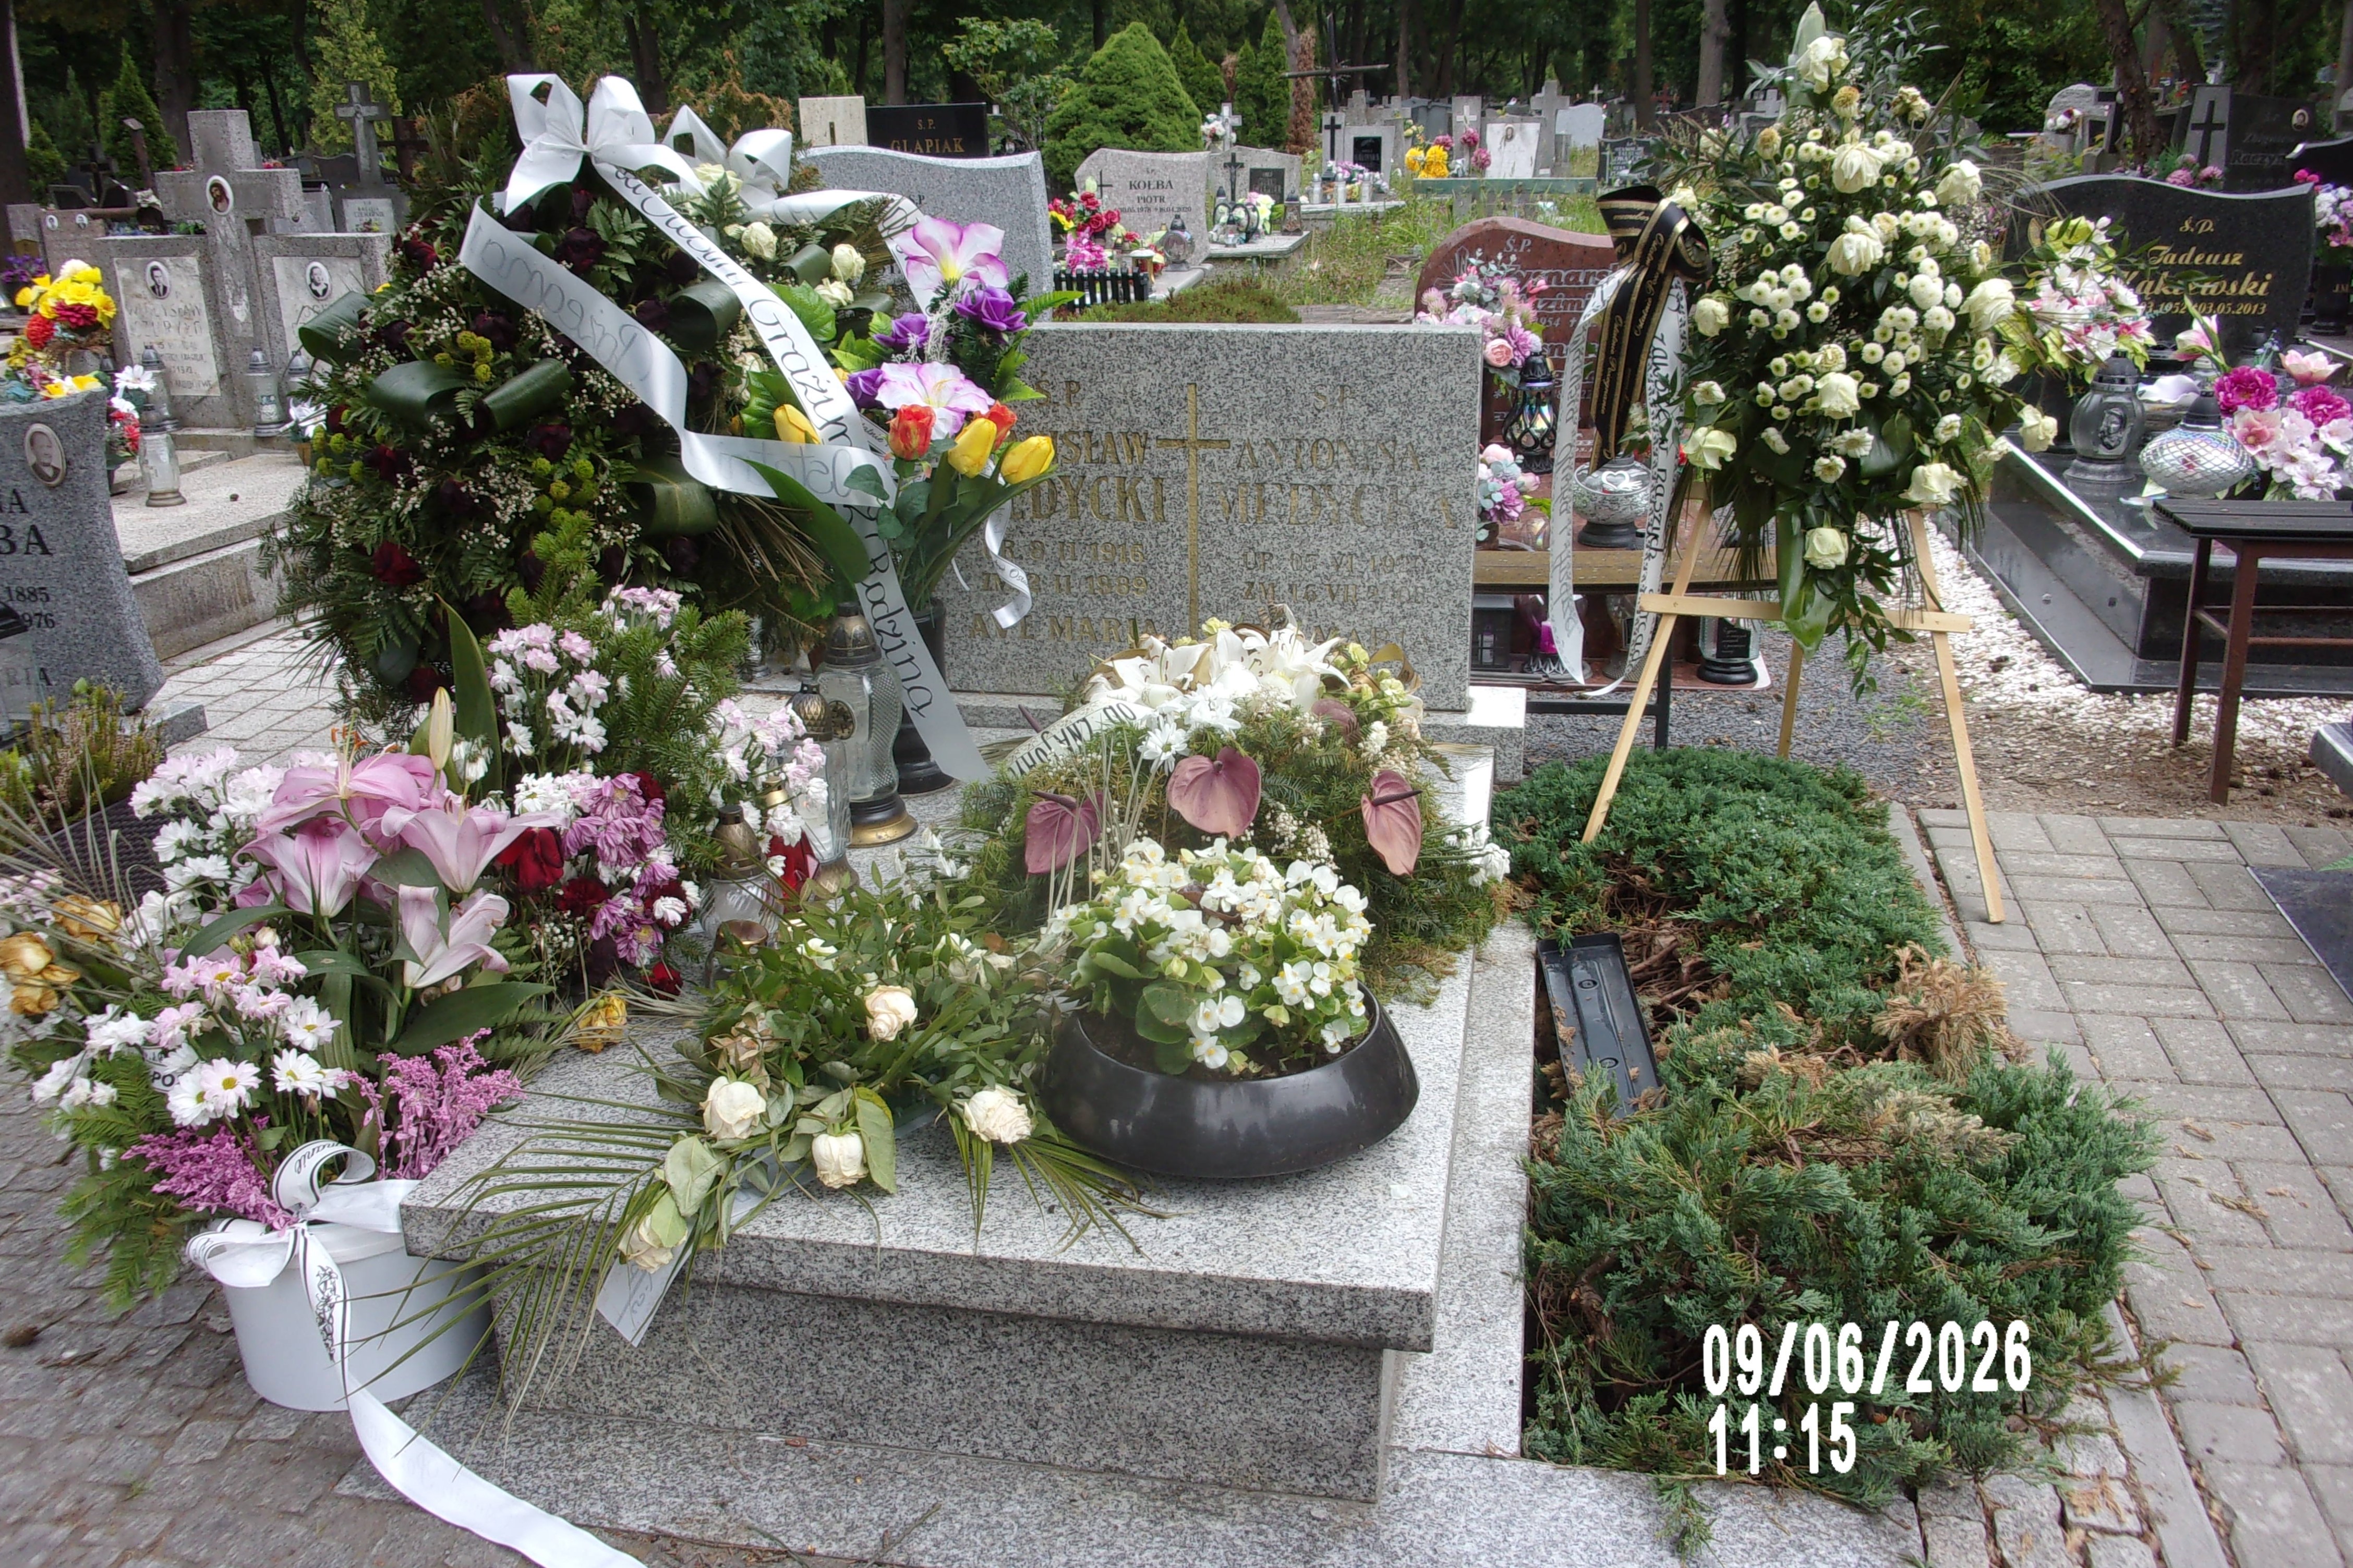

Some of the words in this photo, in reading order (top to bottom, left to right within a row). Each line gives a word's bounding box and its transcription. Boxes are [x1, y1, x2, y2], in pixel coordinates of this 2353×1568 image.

[891, 138, 965, 153] GLAPIAK
[1129, 180, 1174, 190] KOŁBA
[1137, 195, 1166, 203] PIOTR
[2147, 245, 2243, 265] Tadeusz
[5, 586, 50, 602] 1885
[22, 612, 55, 628] 976
